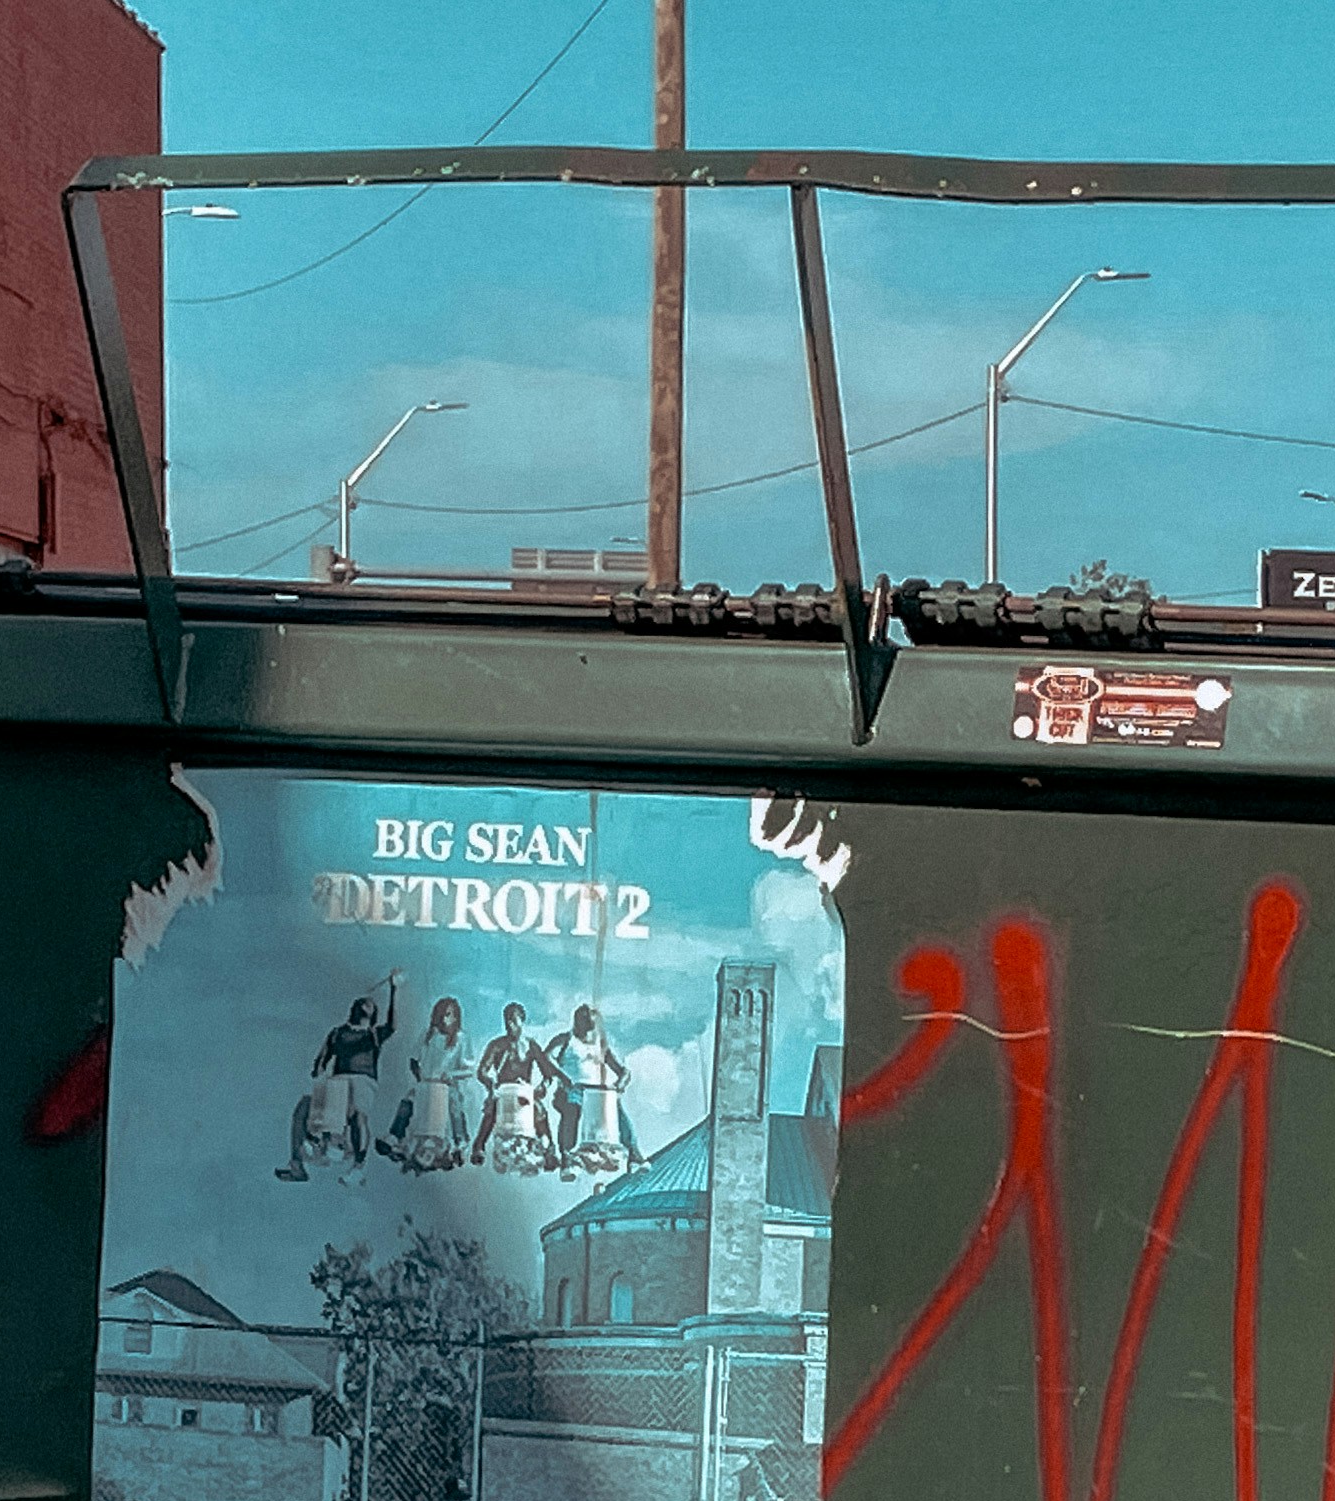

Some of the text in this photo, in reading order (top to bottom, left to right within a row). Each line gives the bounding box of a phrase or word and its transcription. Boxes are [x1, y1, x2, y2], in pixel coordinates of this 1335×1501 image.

[372, 818, 592, 867] BIG SEAN
[322, 872, 650, 939] DETROIT 2
